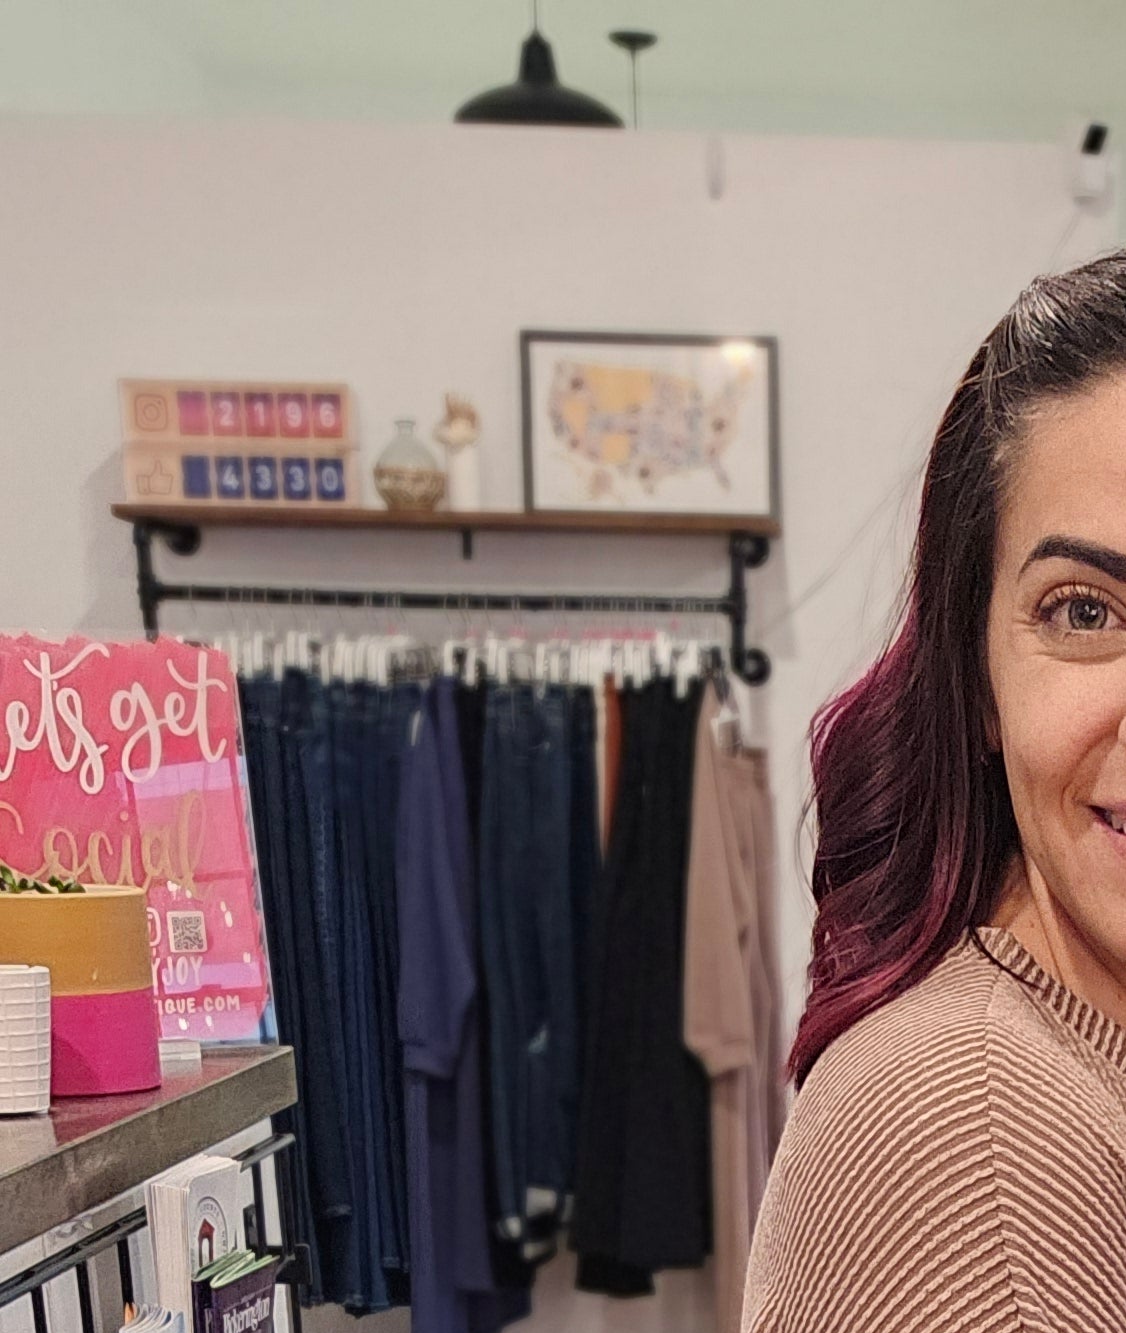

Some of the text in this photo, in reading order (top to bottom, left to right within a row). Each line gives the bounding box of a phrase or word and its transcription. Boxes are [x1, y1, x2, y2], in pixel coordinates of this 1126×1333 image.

[218, 399, 337, 429] 2196
[222, 464, 339, 493] 4330
[0, 643, 227, 795] et's get
[161, 955, 204, 987] JOY
[154, 993, 242, 1016] IQUE.COM
